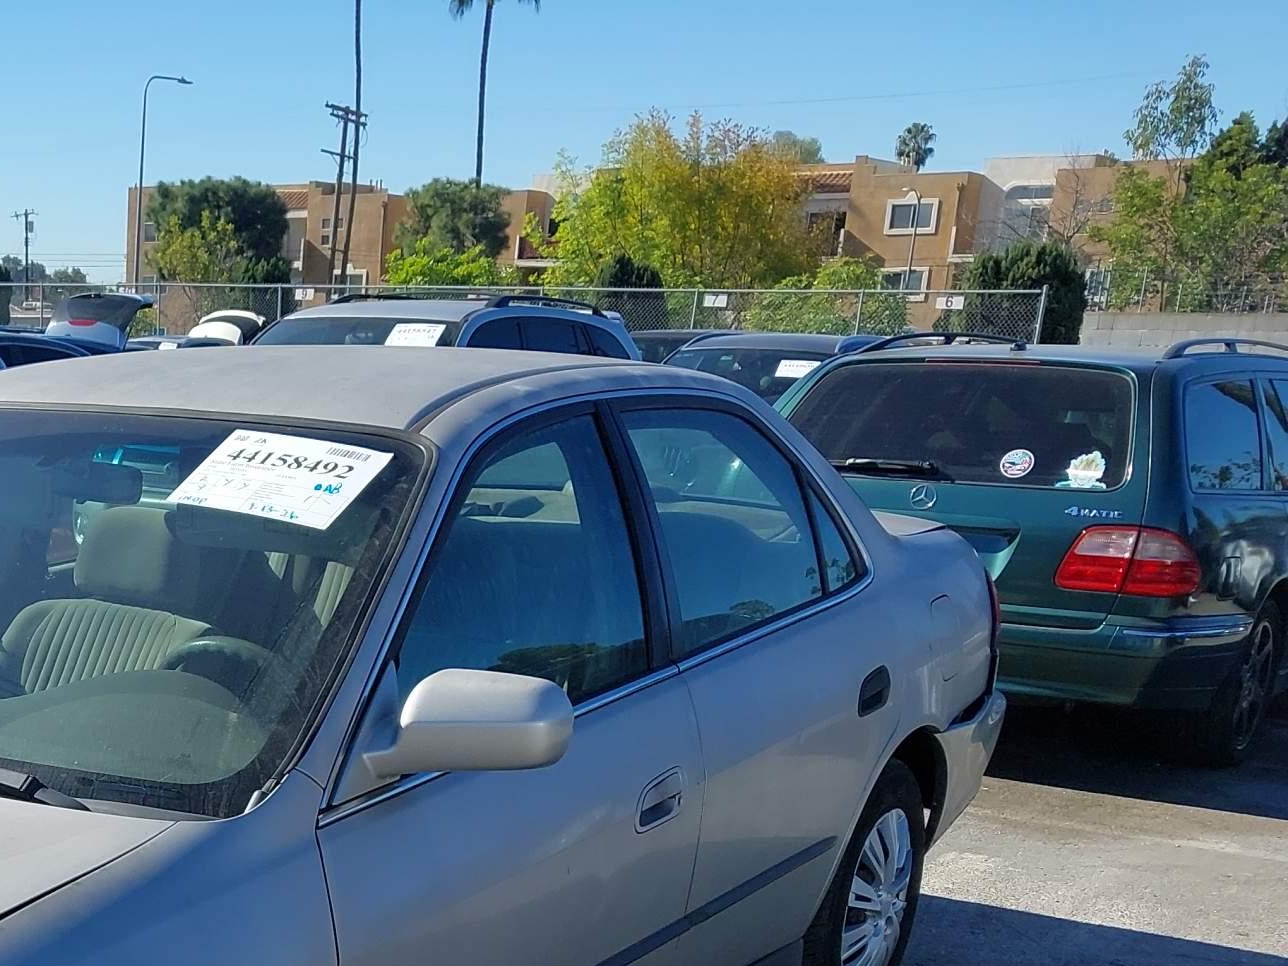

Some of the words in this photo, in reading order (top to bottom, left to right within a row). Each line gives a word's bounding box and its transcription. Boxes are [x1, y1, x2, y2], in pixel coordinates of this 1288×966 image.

[712, 294, 719, 305] 7
[945, 295, 954, 308] 6
[226, 448, 355, 479] 44158492
